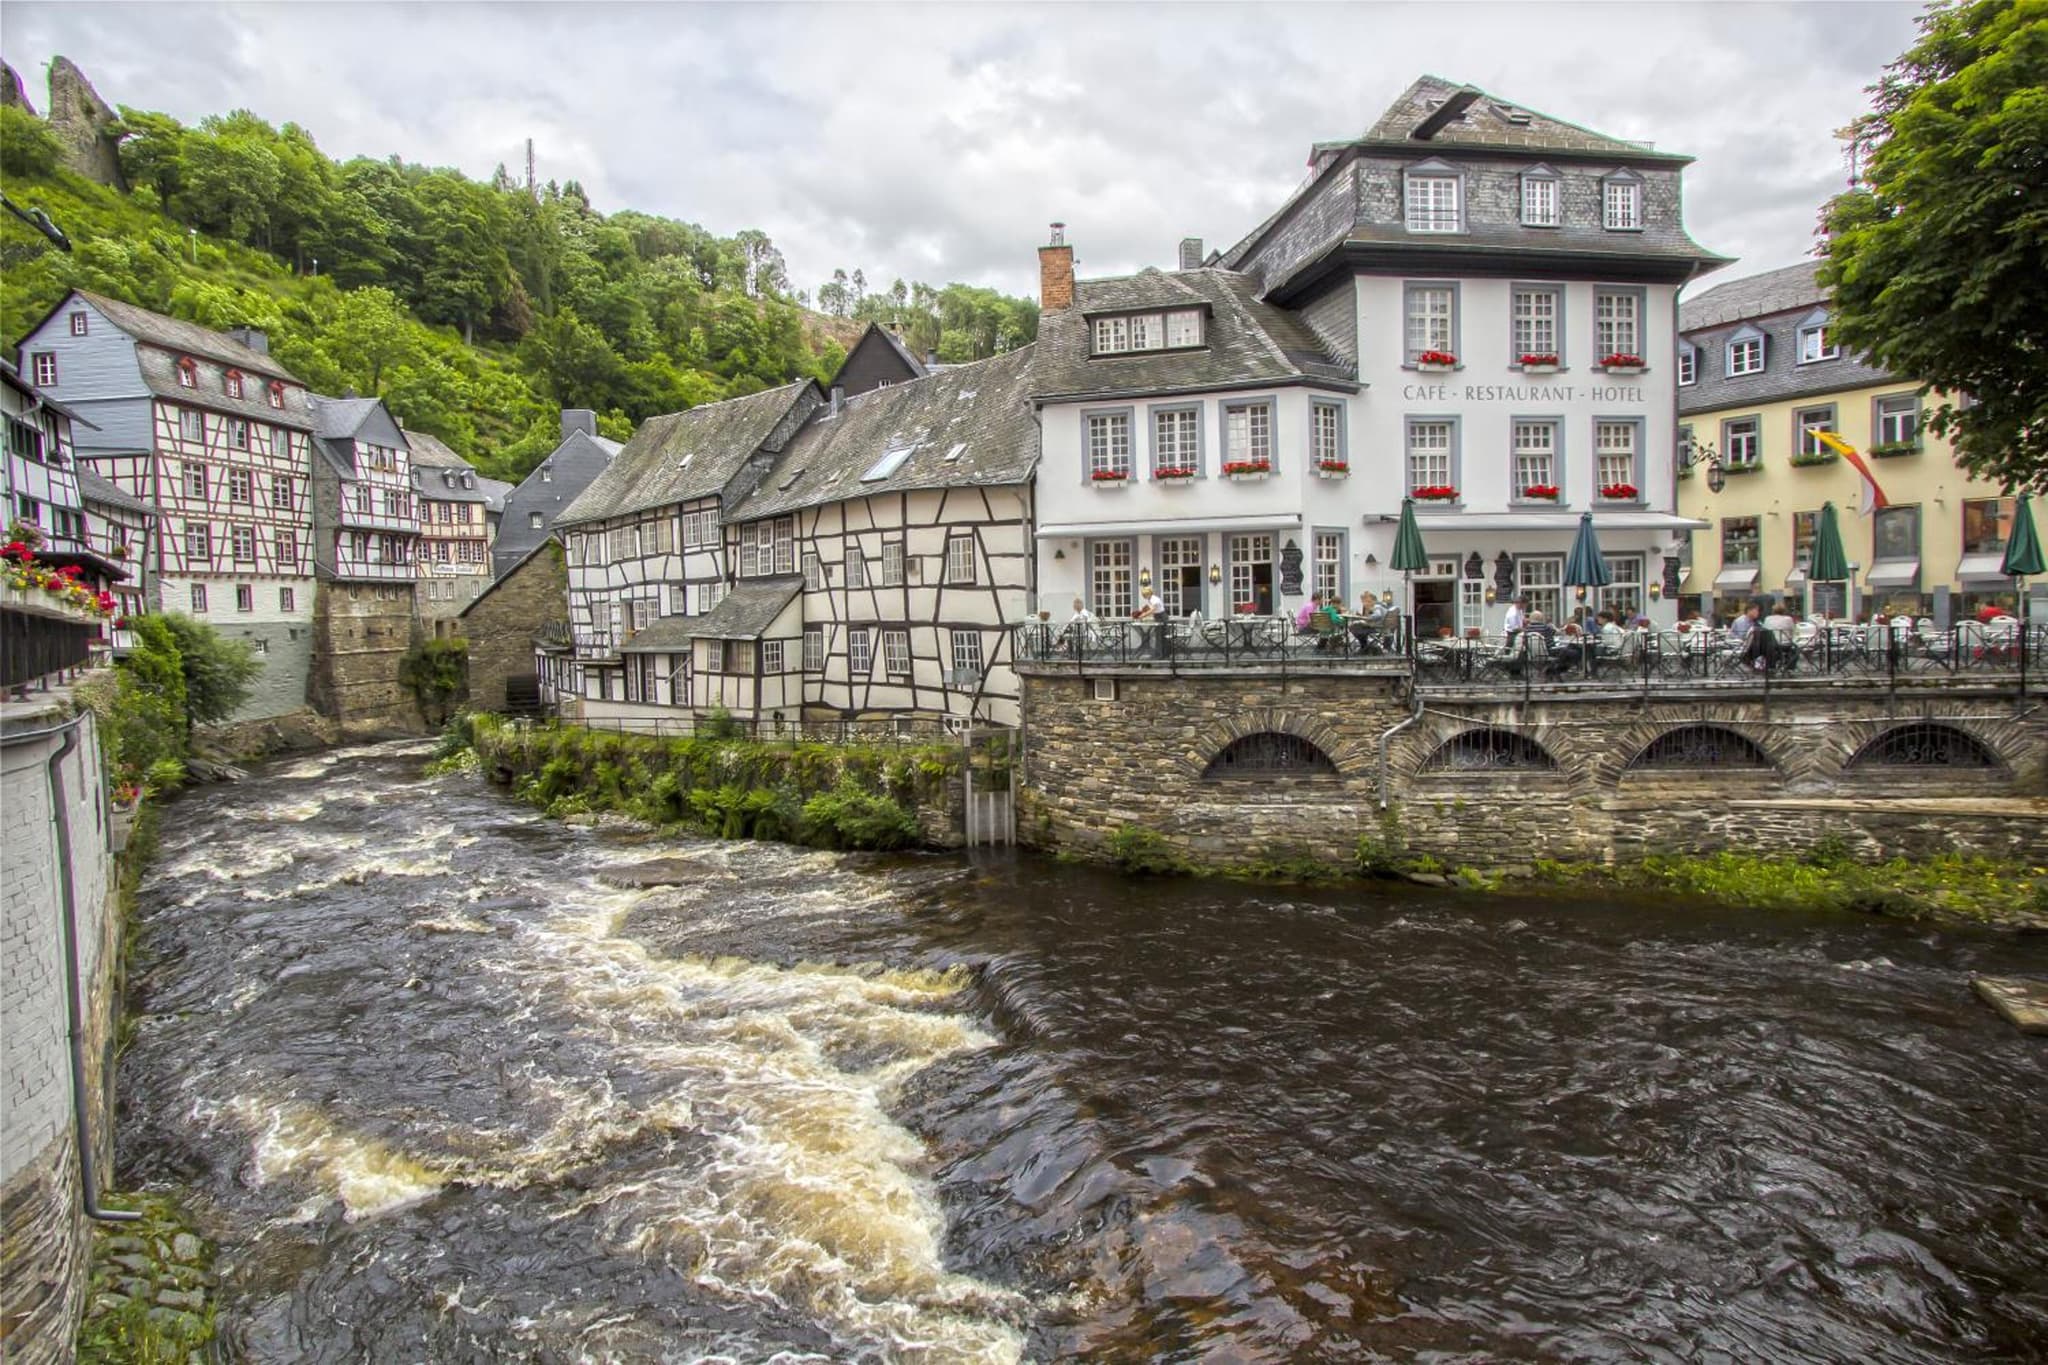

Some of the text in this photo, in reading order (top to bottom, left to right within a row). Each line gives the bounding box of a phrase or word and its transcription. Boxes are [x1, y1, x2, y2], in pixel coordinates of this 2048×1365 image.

[1403, 382, 1448, 400] CAFÉ
[1465, 385, 1575, 401] RESTAURANT
[1592, 386, 1646, 402] HOTEL
